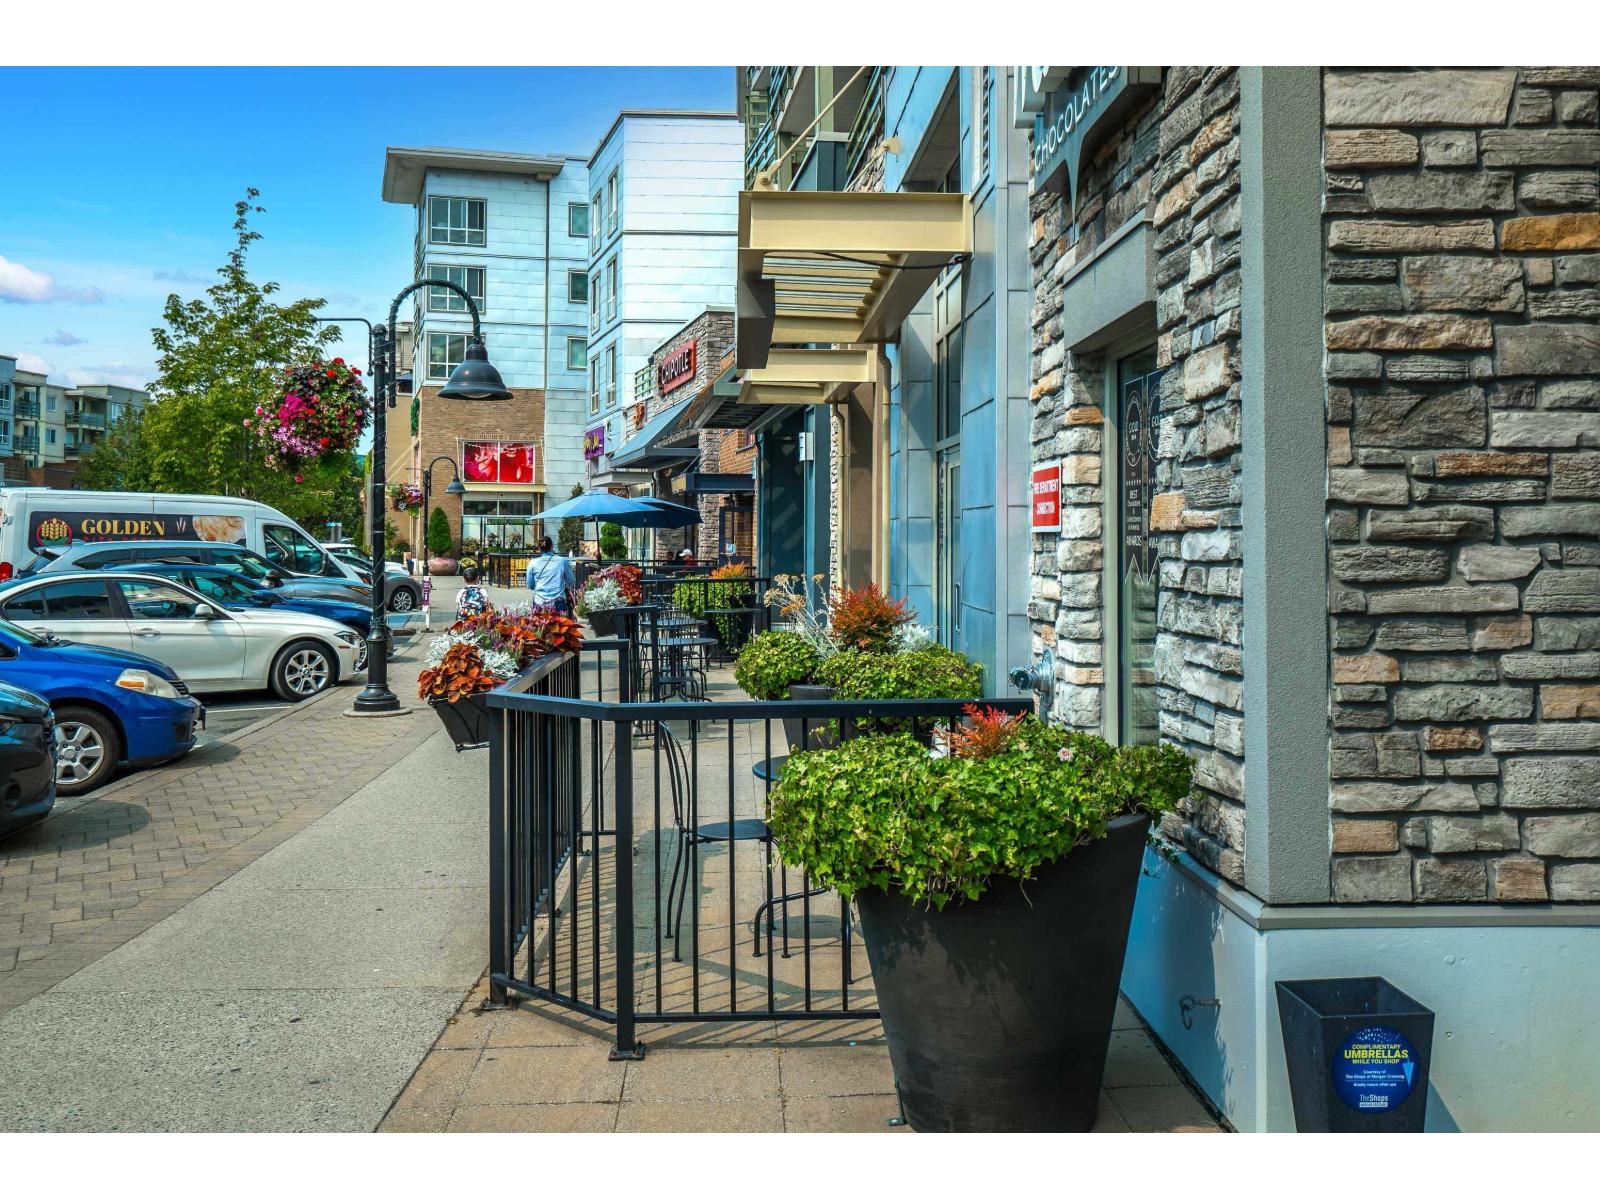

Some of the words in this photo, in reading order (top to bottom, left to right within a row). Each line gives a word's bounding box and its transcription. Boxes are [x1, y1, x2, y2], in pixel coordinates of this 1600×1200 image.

[662, 349, 689, 384] CHIPOTLE
[81, 519, 165, 535] GOLDEN
[1344, 1049, 1408, 1059] UMBRELLAS
